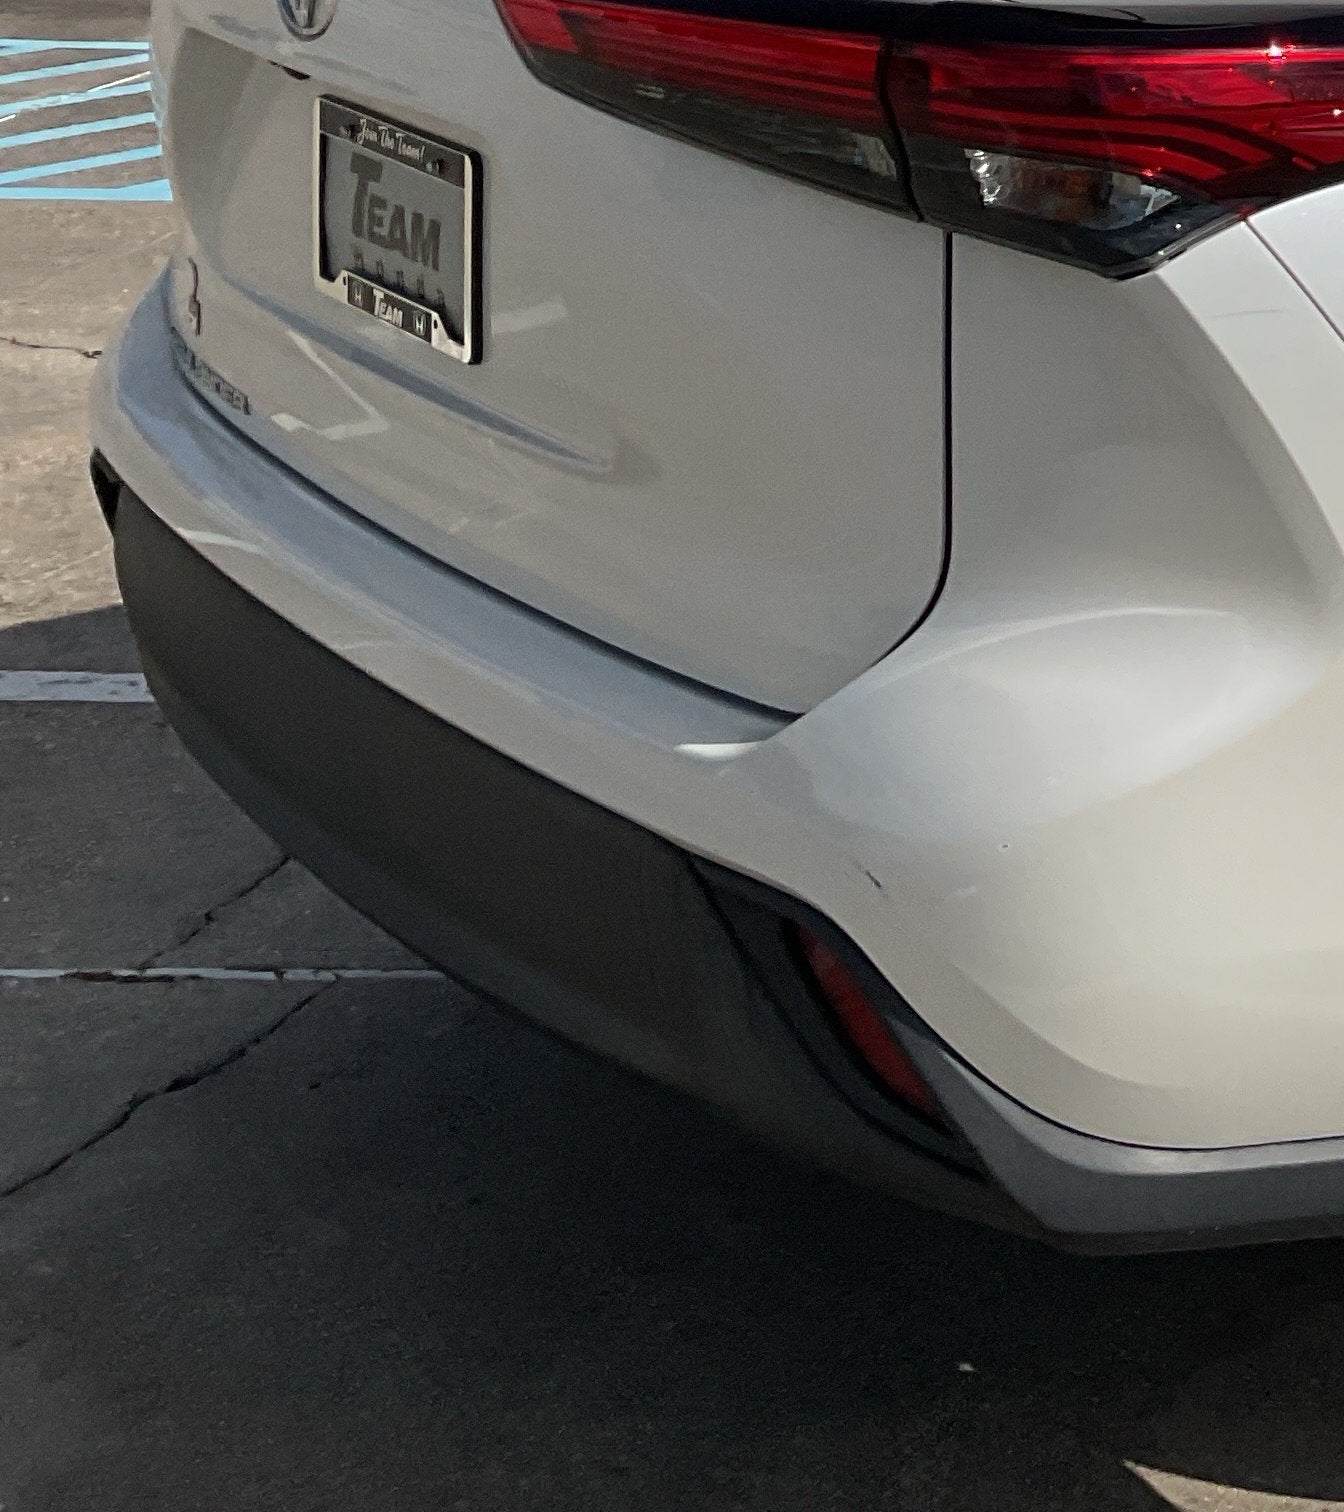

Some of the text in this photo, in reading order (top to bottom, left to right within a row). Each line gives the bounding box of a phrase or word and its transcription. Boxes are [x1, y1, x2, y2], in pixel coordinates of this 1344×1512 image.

[357, 118, 426, 162] Join The Team!
[350, 151, 441, 273] TEAM
[372, 288, 403, 328] TEAM
